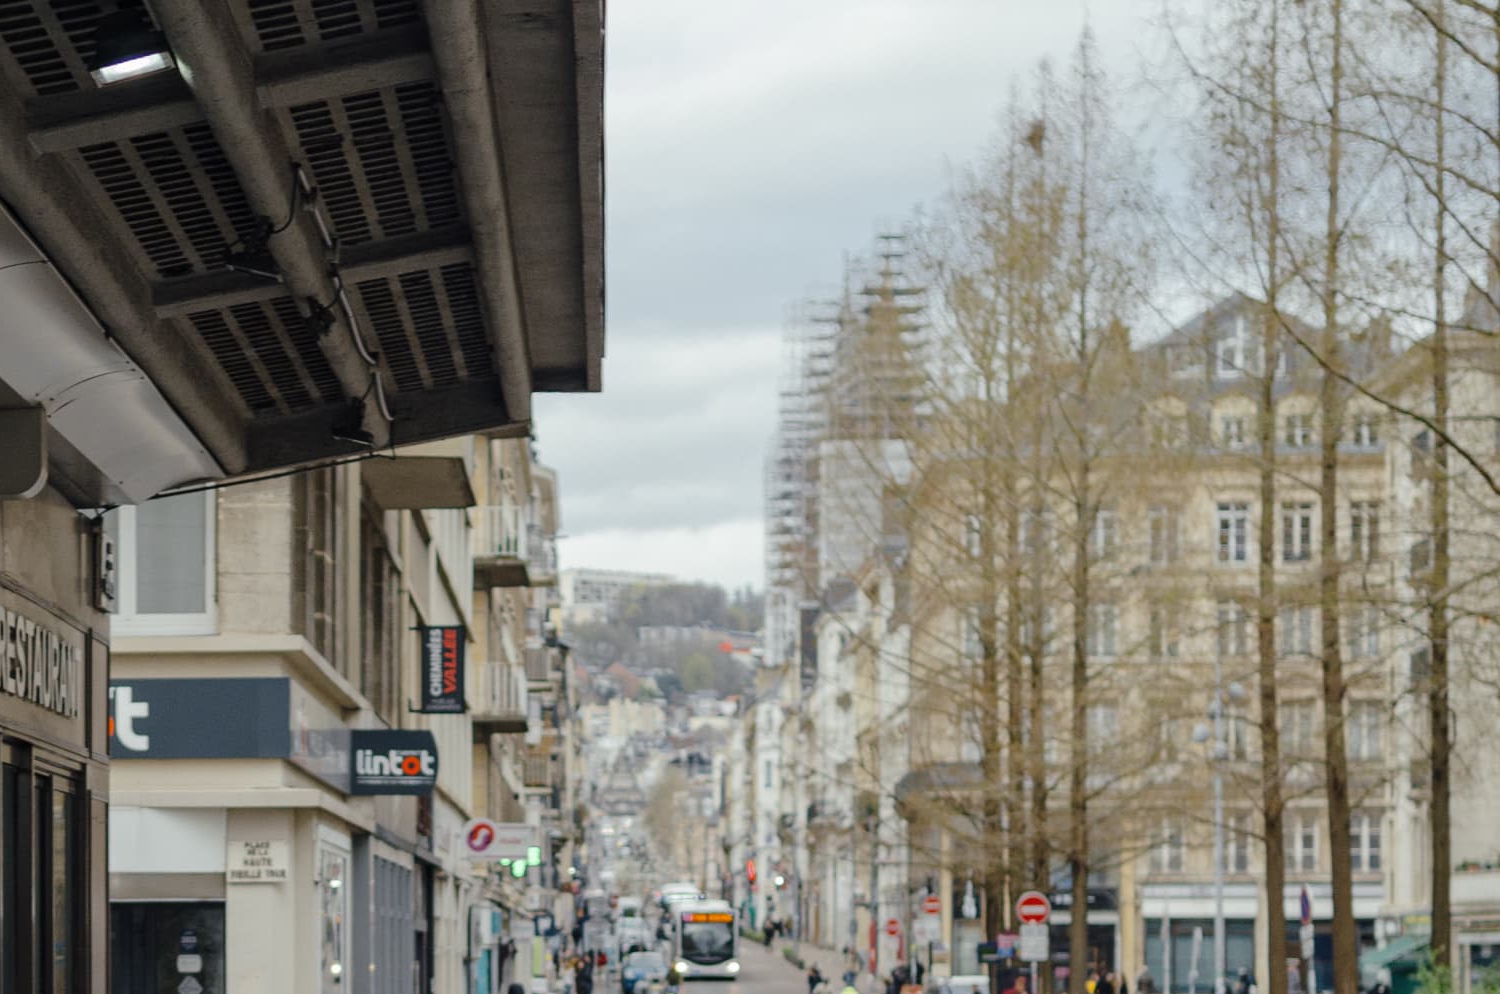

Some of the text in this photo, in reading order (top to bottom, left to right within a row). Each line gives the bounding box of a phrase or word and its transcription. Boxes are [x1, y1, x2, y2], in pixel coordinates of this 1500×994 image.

[427, 629, 442, 697] CHEMINÉES
[108, 686, 150, 752] t
[356, 748, 436, 776] lintot
